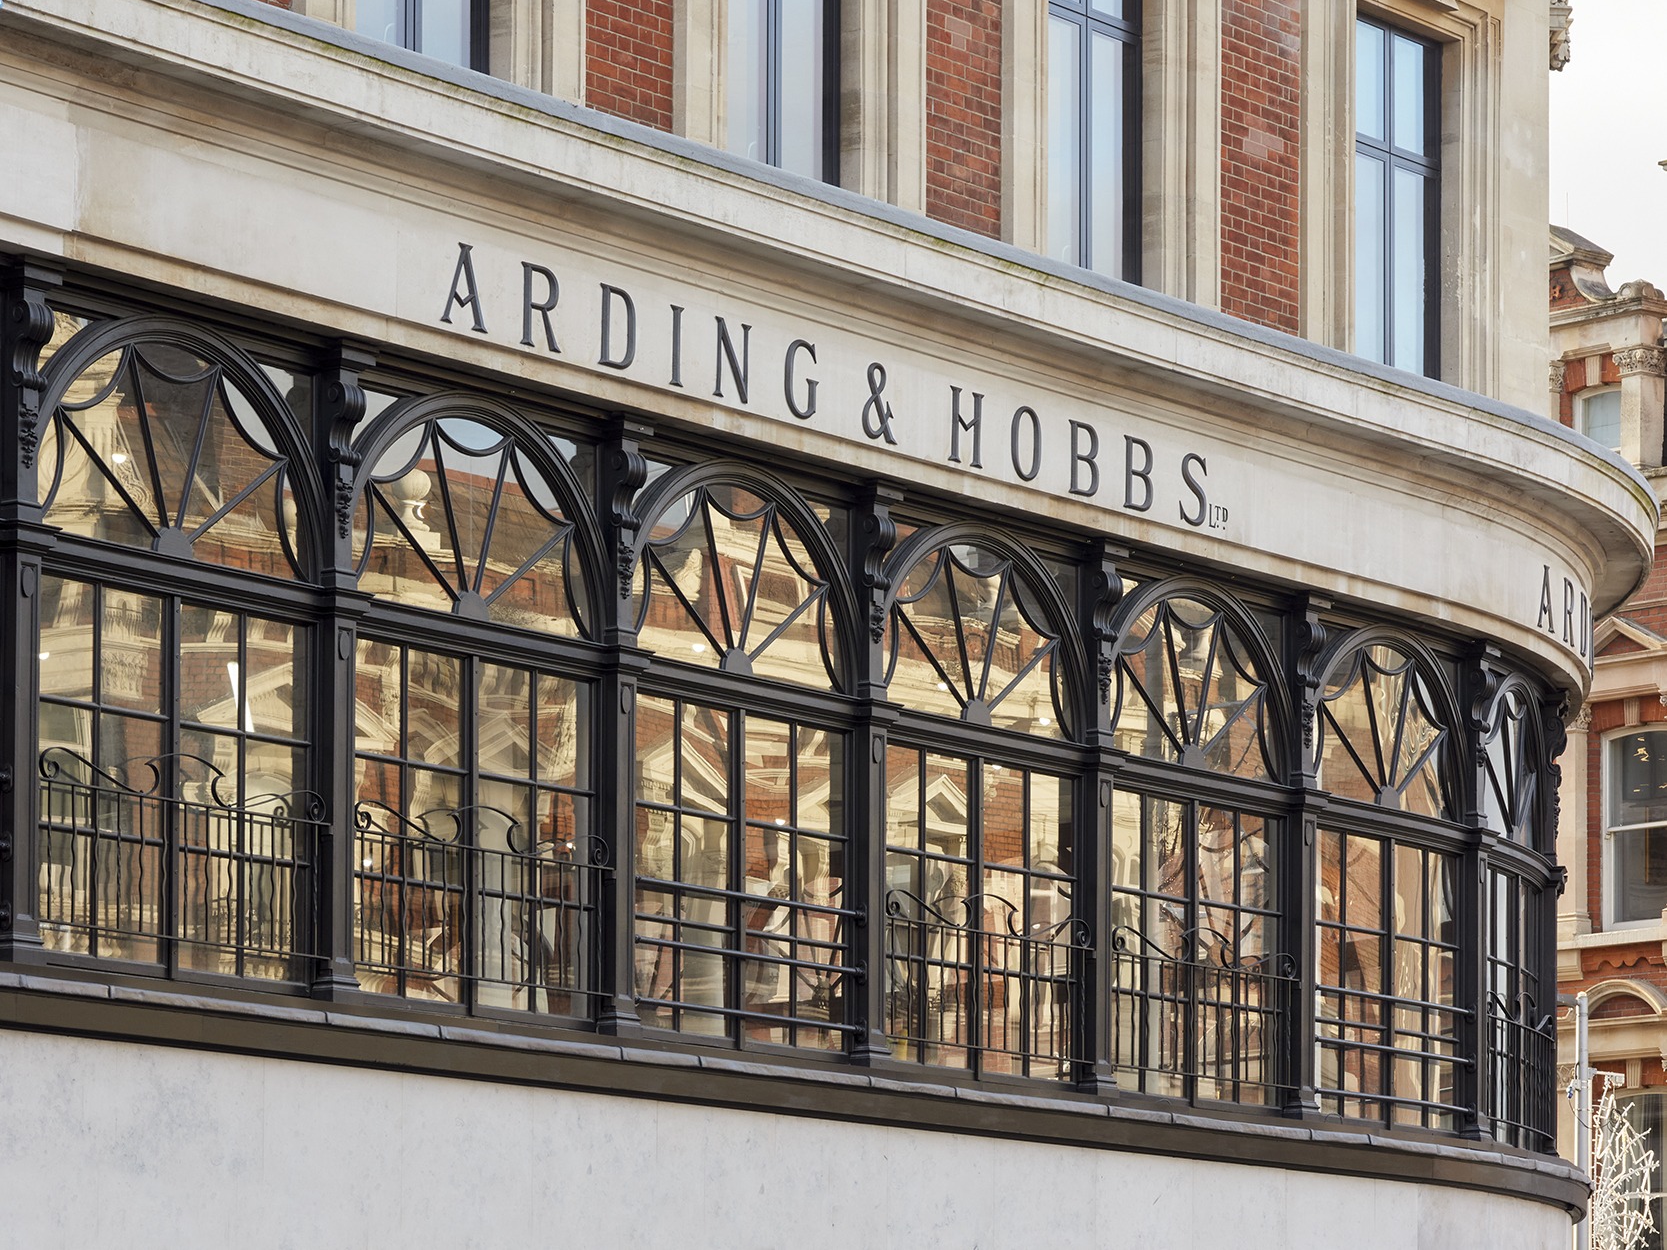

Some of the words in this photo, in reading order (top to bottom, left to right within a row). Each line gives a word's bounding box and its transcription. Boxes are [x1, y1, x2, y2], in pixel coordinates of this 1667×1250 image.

[440, 242, 819, 420] ARDING
[861, 362, 898, 445] &
[947, 385, 1208, 527] HOBBS
